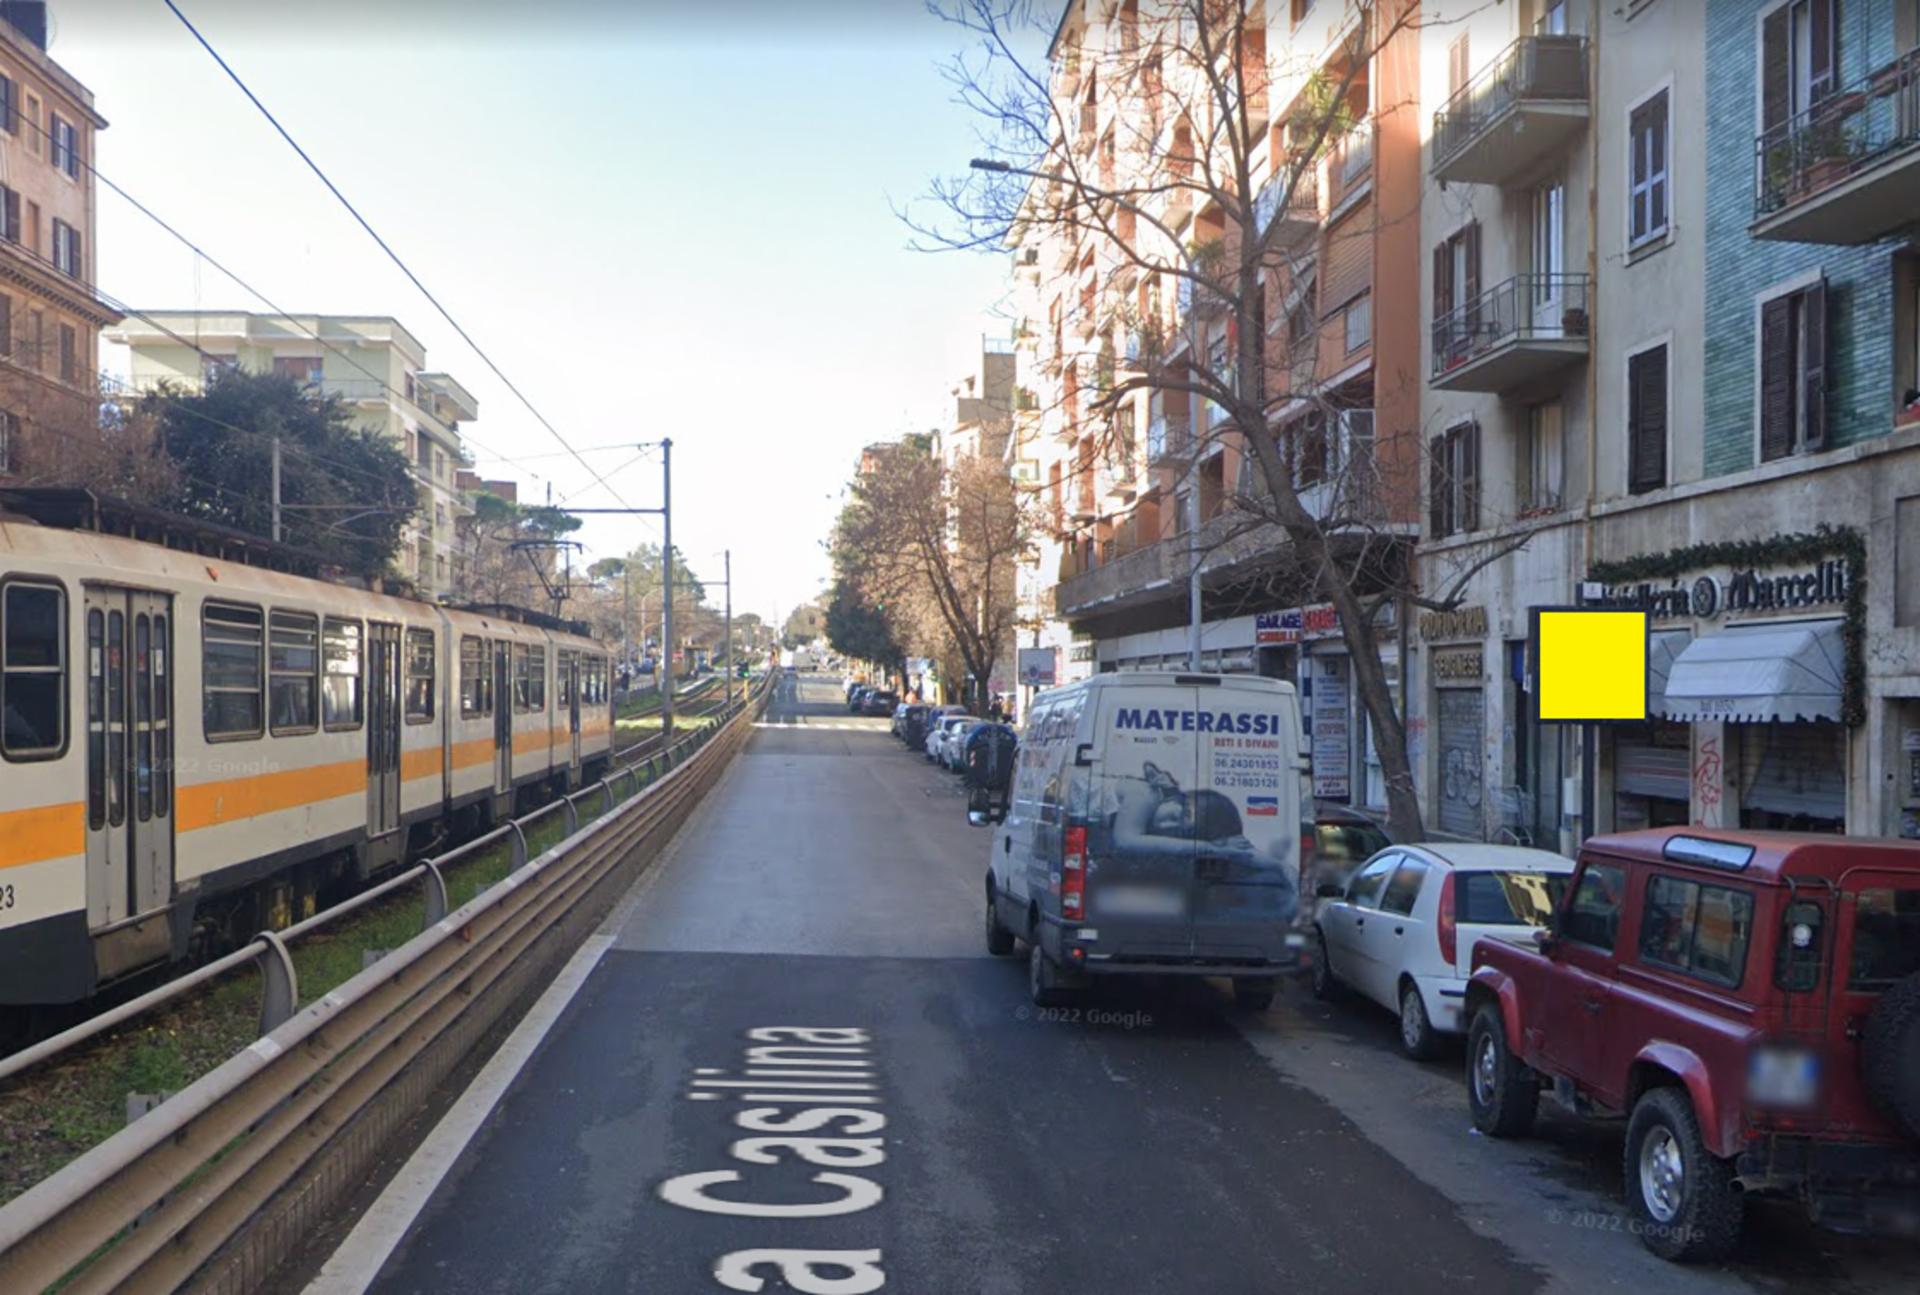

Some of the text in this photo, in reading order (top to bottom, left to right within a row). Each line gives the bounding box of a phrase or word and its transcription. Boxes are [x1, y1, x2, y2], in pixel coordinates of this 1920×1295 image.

[1727, 559, 1846, 611] Marcelli
[1257, 611, 1302, 629] GARAGE
[1116, 708, 1279, 735] MATERASSI
[1214, 737, 1234, 748] RETI
[1245, 739, 1279, 749] DIVANI
